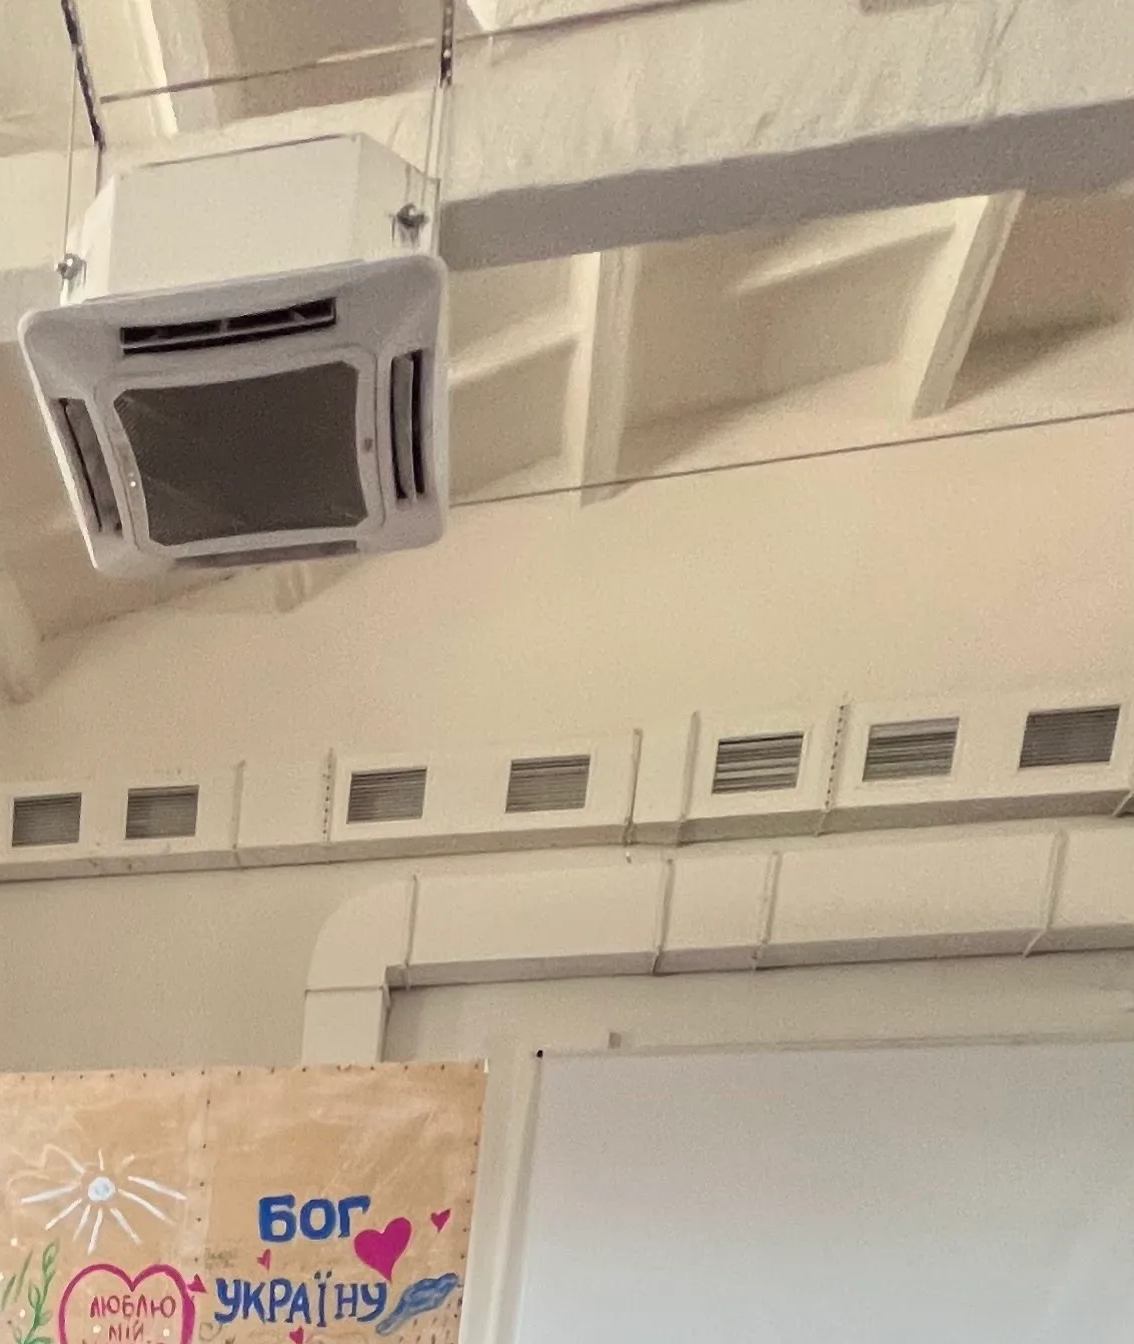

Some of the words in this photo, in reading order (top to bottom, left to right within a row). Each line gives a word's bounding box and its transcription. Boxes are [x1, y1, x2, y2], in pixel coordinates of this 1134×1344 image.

[258, 1195, 371, 1242] БОГ
[90, 1295, 176, 1319] ЛЮБЛЮ
[214, 1270, 388, 1328] УКРАЇНУ
